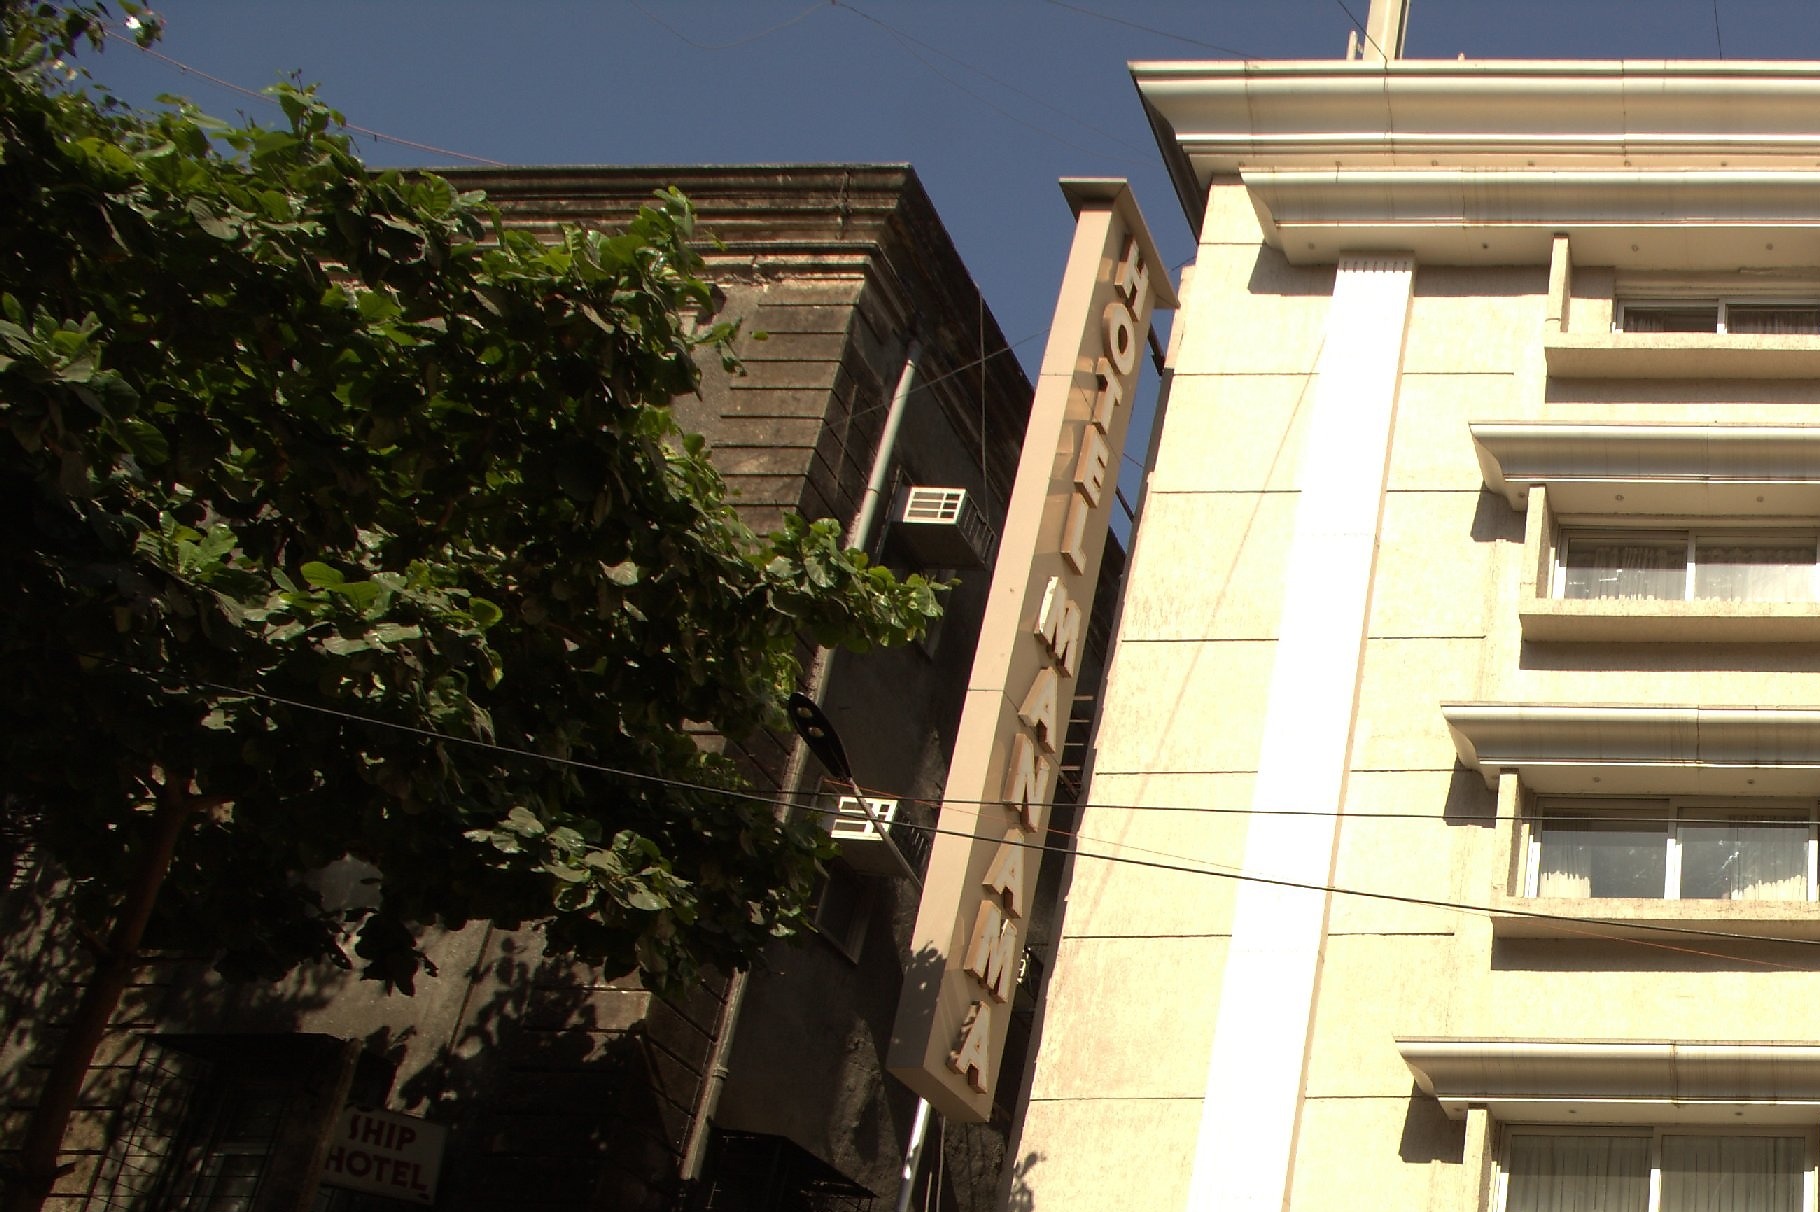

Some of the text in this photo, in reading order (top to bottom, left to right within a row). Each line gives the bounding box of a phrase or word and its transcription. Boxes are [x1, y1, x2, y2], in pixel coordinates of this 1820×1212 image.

[946, 232, 1150, 1095] HOTEL MANAMA
[324, 1146, 429, 1192] HOTEL
